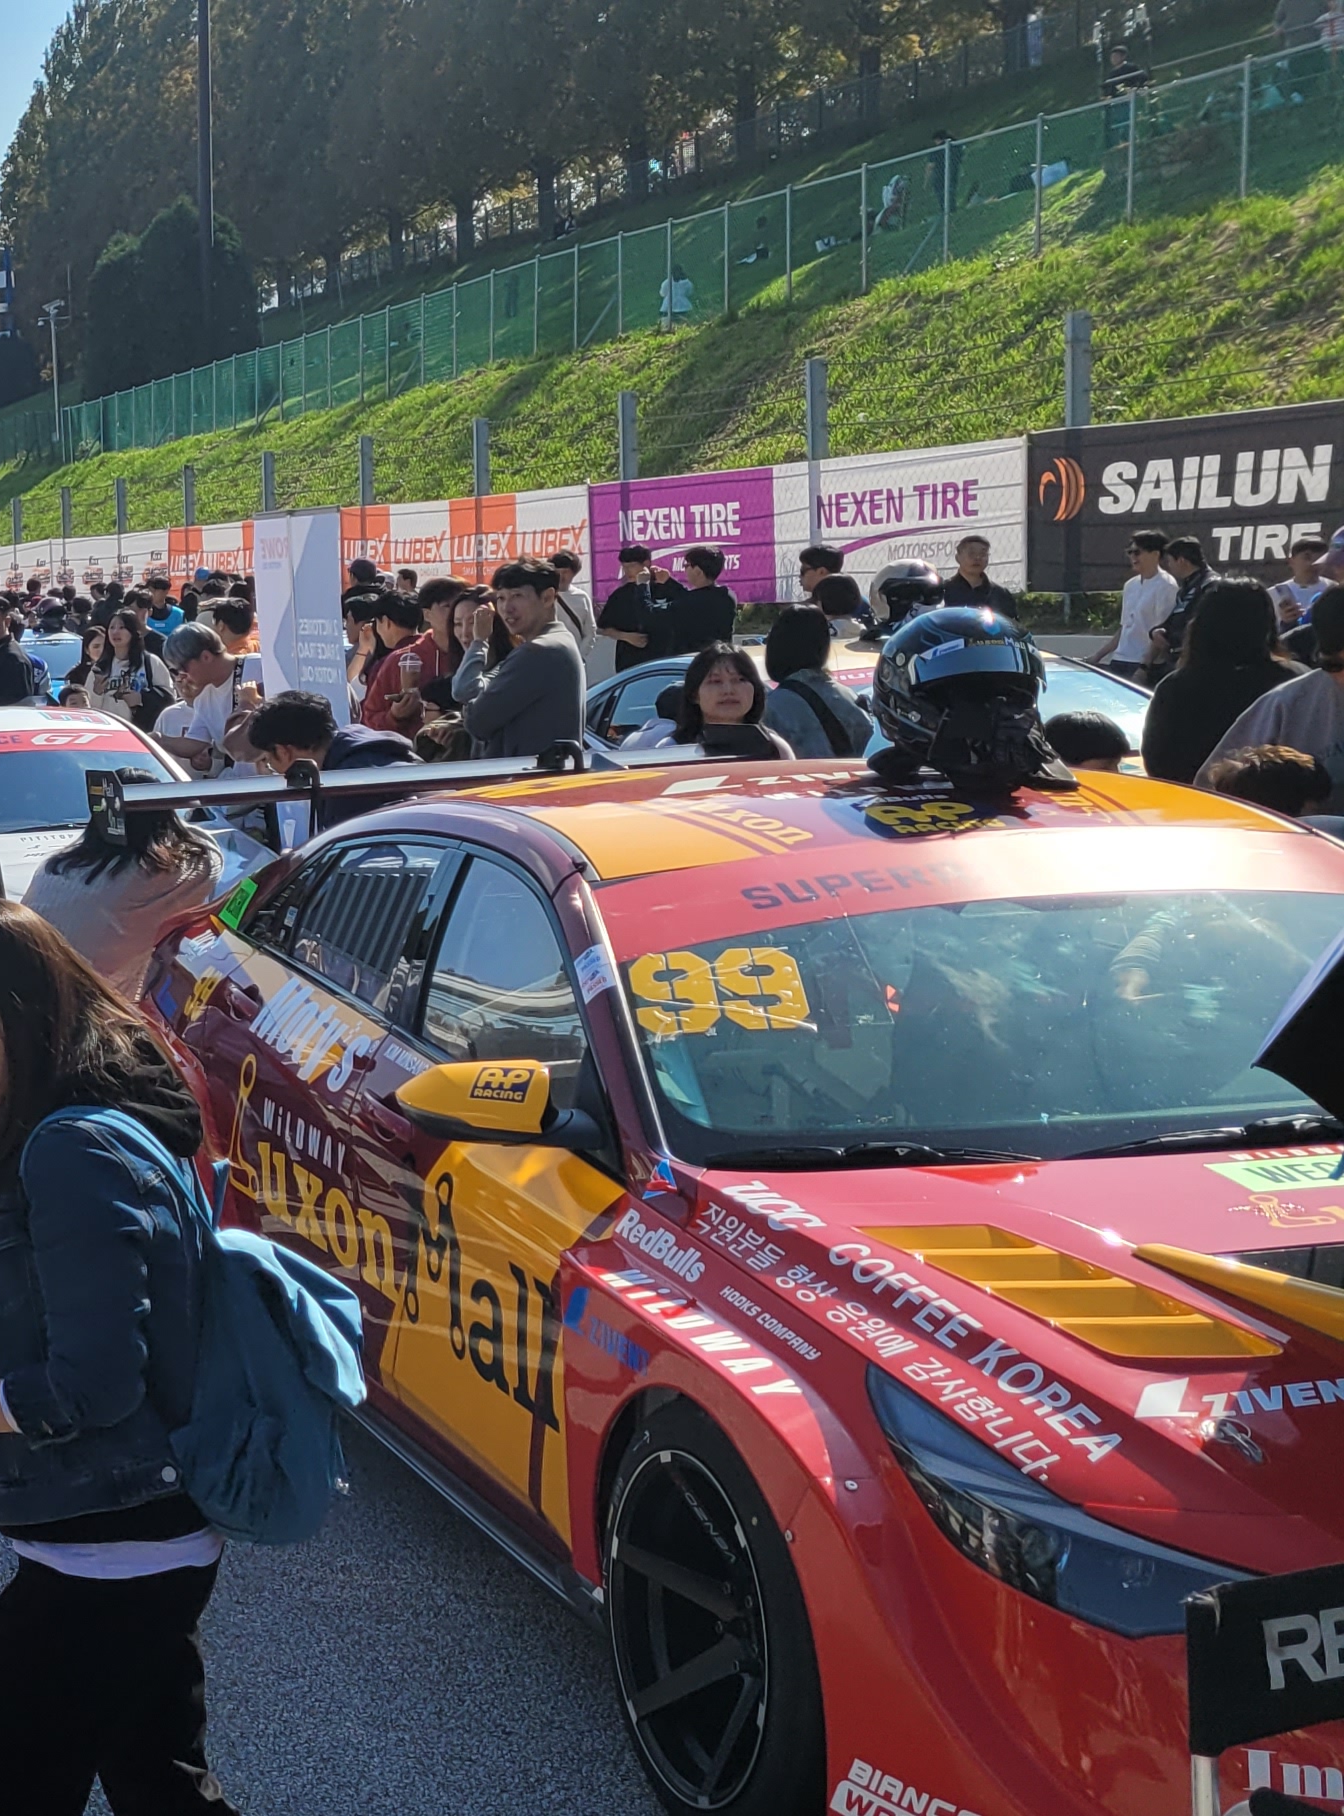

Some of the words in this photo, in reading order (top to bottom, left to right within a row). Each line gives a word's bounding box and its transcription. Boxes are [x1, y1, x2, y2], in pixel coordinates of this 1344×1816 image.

[1098, 445, 1333, 514] SAILUN
[620, 507, 687, 542] NEXEN
[690, 502, 742, 538] TIRE
[814, 488, 904, 529] NEXEN
[912, 480, 980, 520] TIRE
[393, 531, 448, 563] LUBEX
[31, 730, 115, 747] GT
[629, 946, 810, 1036] 99
[472, 1088, 525, 1101] RACING
[475, 1068, 531, 1088] AP
[1228, 1145, 1344, 1161] WILDW
[615, 1207, 707, 1284] RedBulls
[719, 1285, 760, 1319] HOOKS
[755, 1311, 822, 1362] COMPANY
[721, 1180, 828, 1232] UCC
[828, 1242, 984, 1349] COFFEE
[968, 1337, 1123, 1464] KOREA
[775, 1263, 839, 1303] 항상
[824, 1300, 919, 1359] 응원에
[902, 1356, 1060, 1481] 감사합니다.
